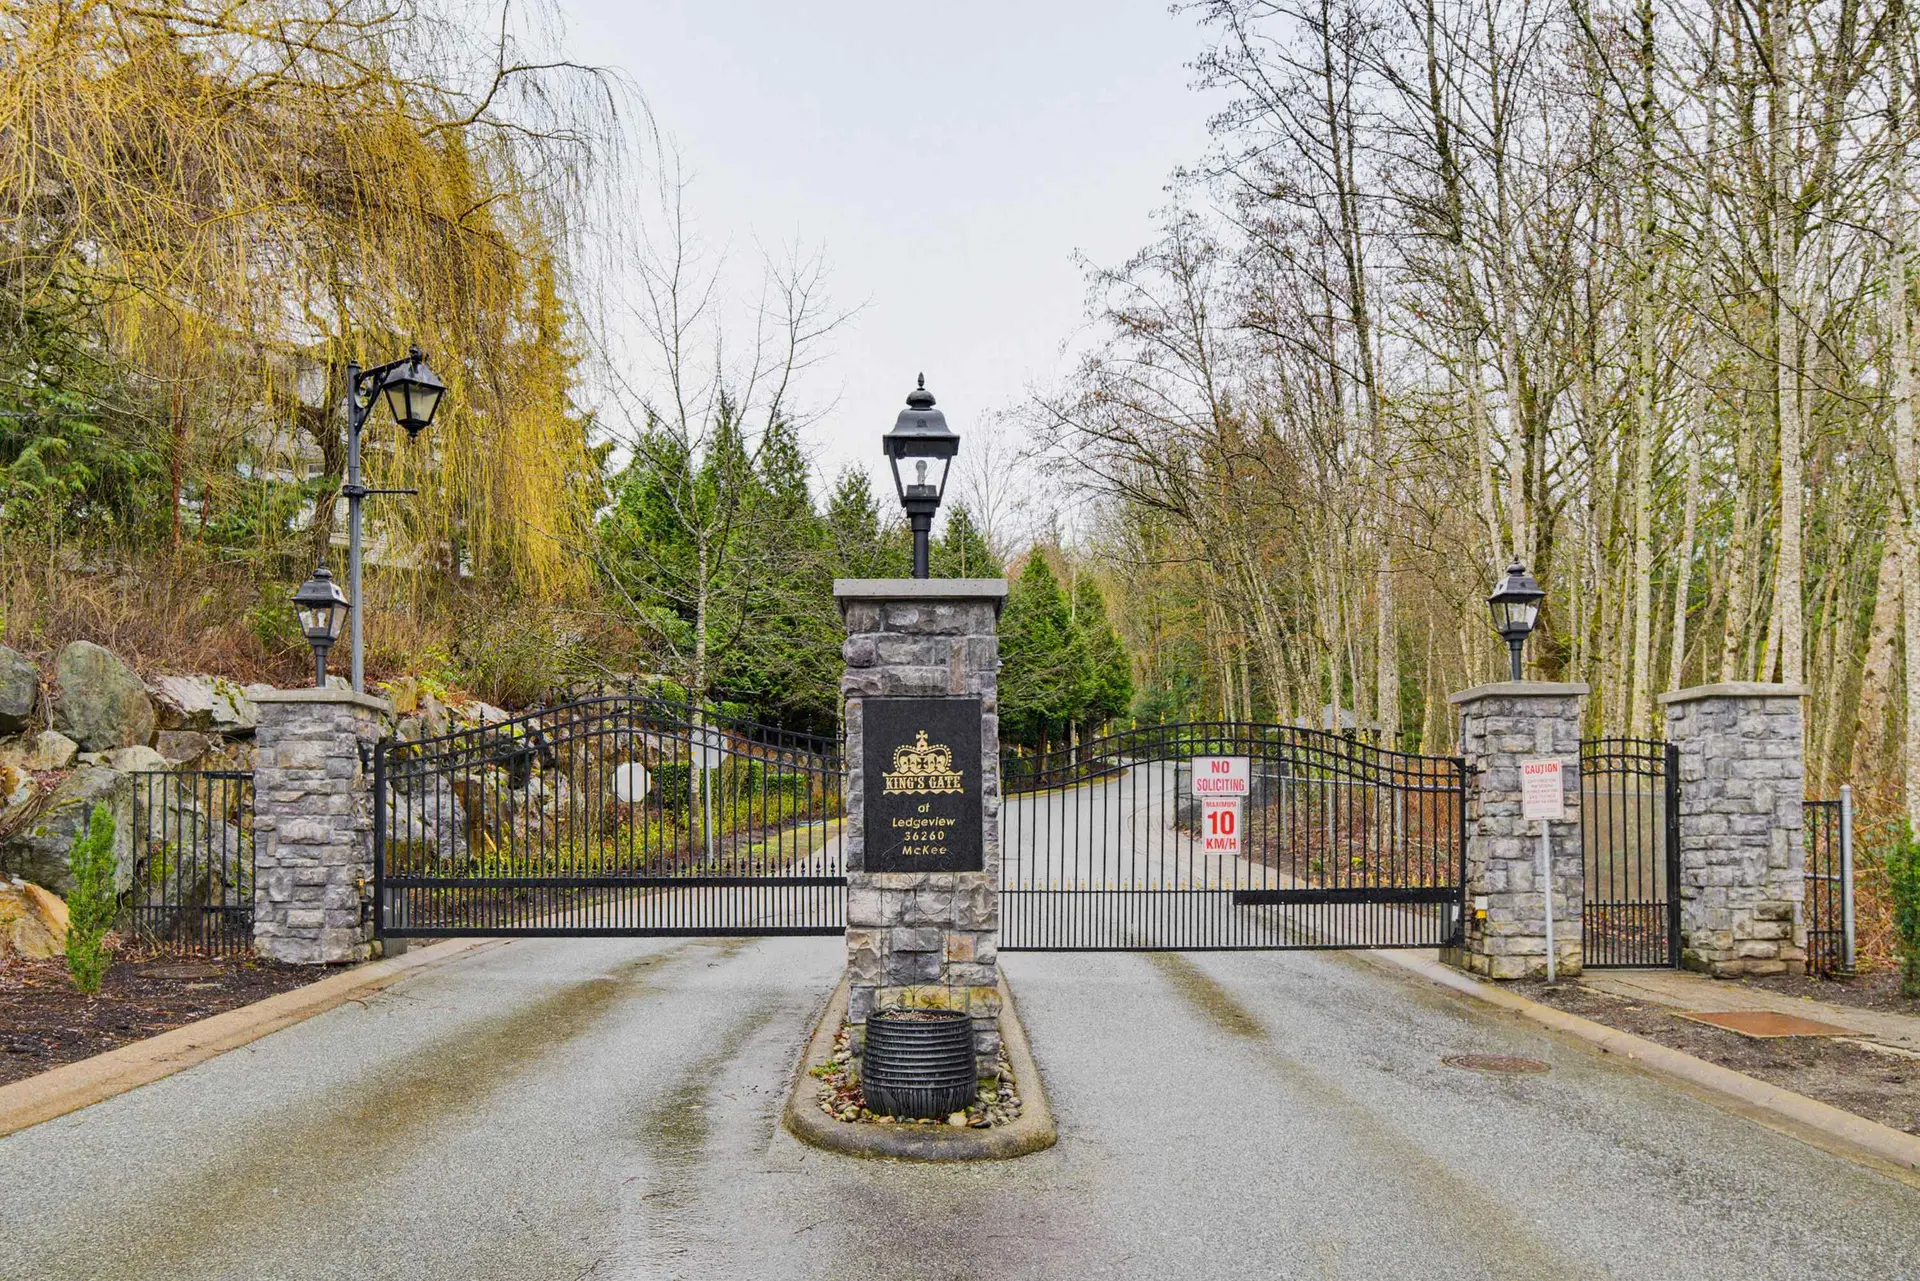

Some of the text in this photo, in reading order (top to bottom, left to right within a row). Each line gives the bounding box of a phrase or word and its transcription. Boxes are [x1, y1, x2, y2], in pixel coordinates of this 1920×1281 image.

[1211, 760, 1230, 774] NO
[1525, 763, 1558, 774] CAUTION
[885, 775, 961, 790] KING'S GATE
[1196, 778, 1245, 792] SOLICITING
[892, 816, 956, 828] Ledgeview
[1207, 810, 1235, 835] 10
[904, 830, 945, 841] 36260
[902, 845, 947, 855] McKee
[1206, 838, 1237, 850] KM/H
